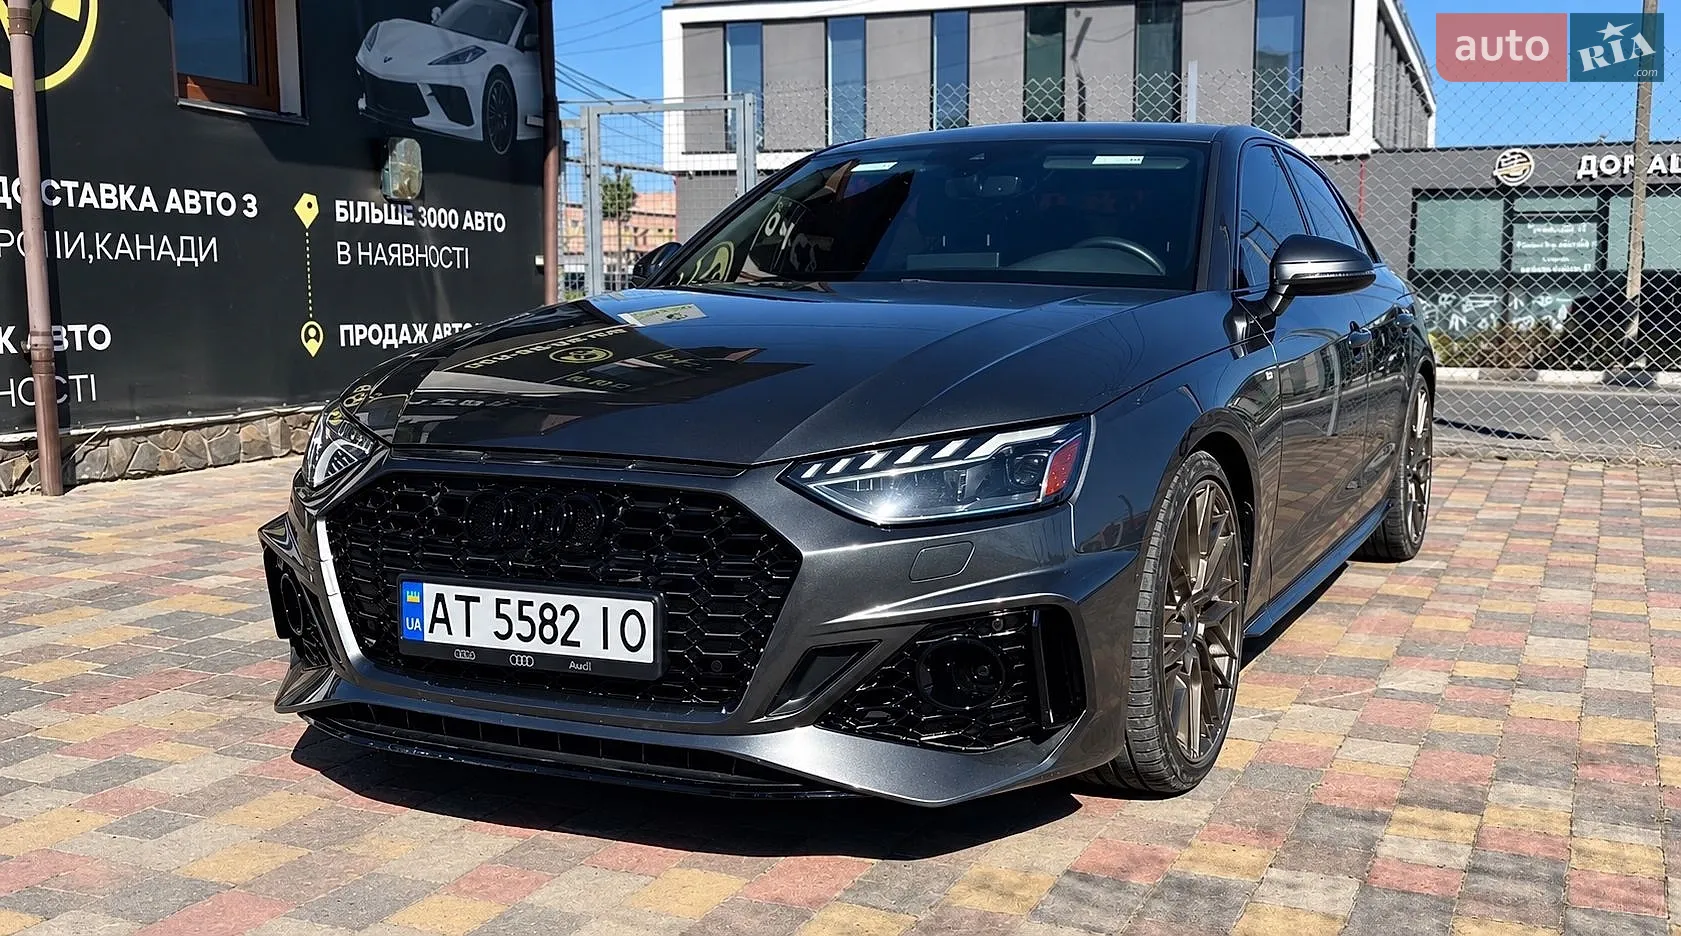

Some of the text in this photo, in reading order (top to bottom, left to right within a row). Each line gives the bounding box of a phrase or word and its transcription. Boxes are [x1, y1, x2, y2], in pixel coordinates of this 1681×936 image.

[164, 188, 237, 217] АВТО
[335, 200, 506, 233] БІЛЬШЕ 3000 АВТО
[336, 241, 469, 269] В НАЯВНОСТІ
[27, 323, 112, 352] ВТО
[340, 323, 429, 350] ПРОДАЖ
[406, 592, 647, 653] UA AT 5582 IO
